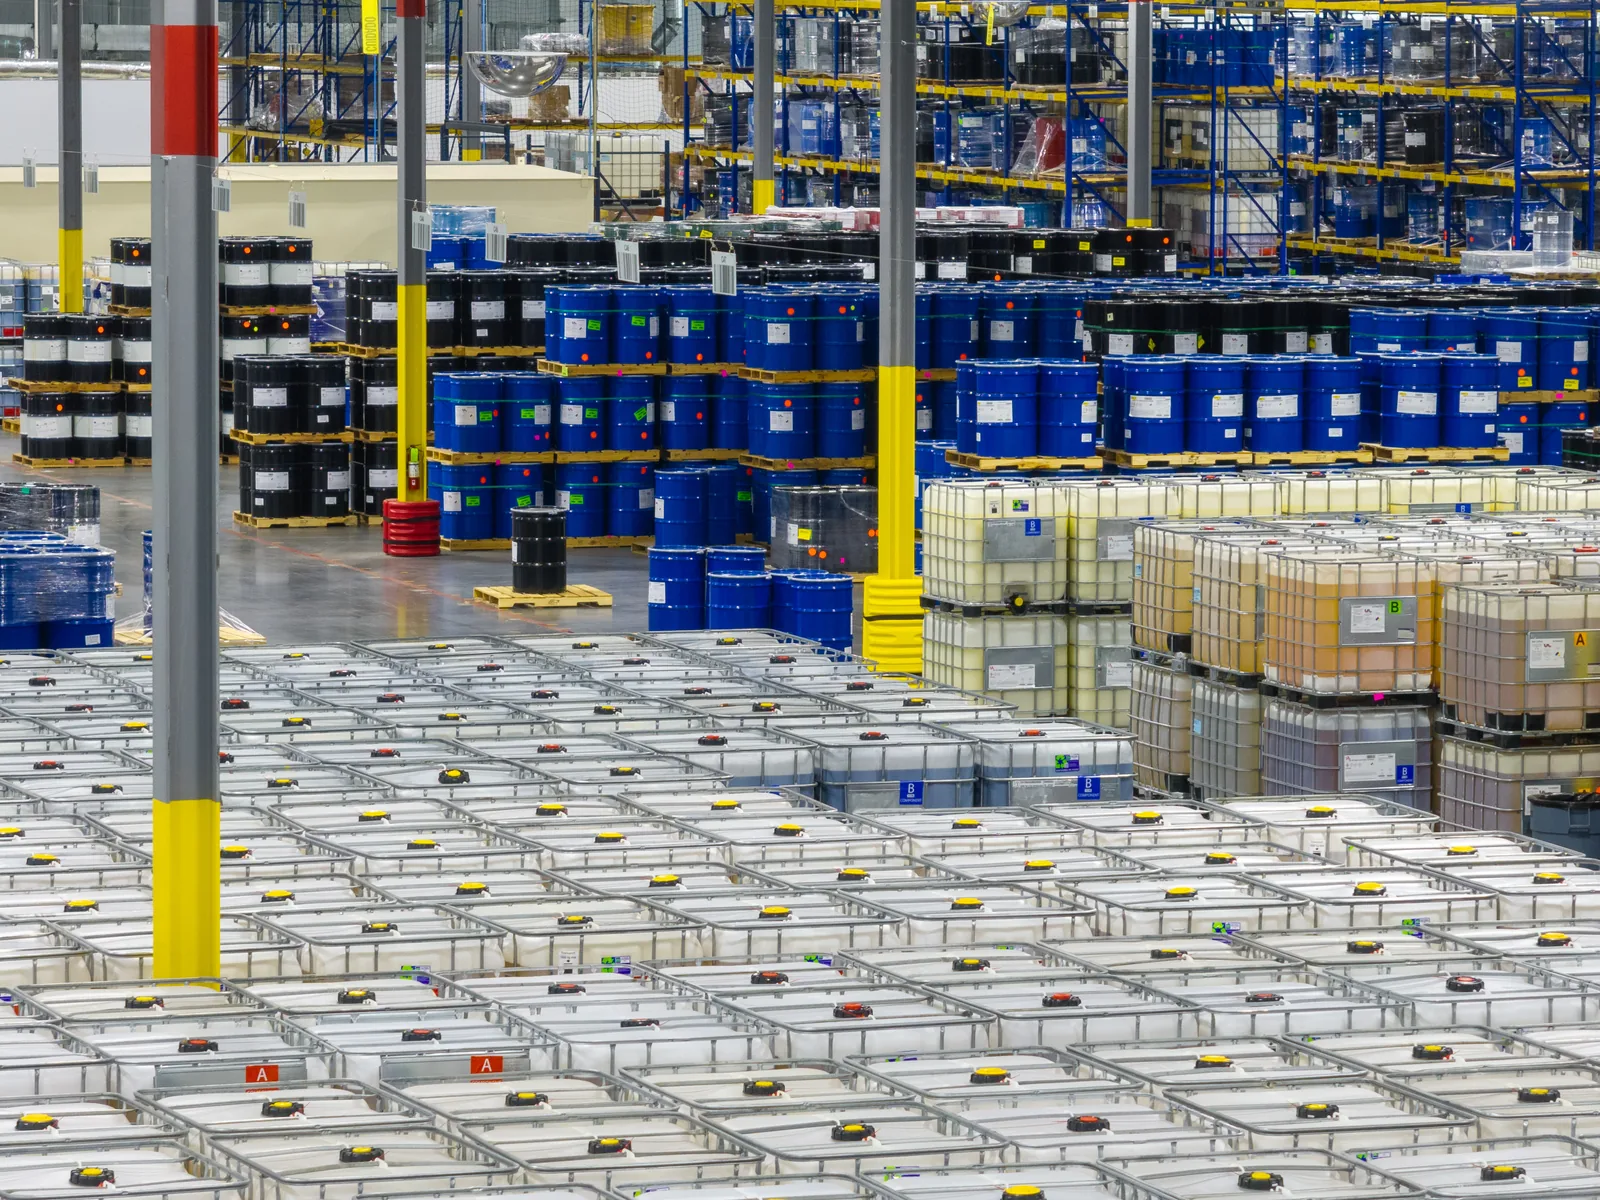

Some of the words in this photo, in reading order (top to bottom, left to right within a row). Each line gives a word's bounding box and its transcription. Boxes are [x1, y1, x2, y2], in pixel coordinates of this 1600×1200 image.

[365, 16, 377, 53] CUIDADO
[1391, 601, 1399, 612] B
[1576, 633, 1585, 645] A
[1402, 767, 1408, 776] B
[907, 783, 915, 793] B
[1085, 778, 1092, 788] B
[480, 1058, 492, 1072] A
[256, 1067, 268, 1081] A
